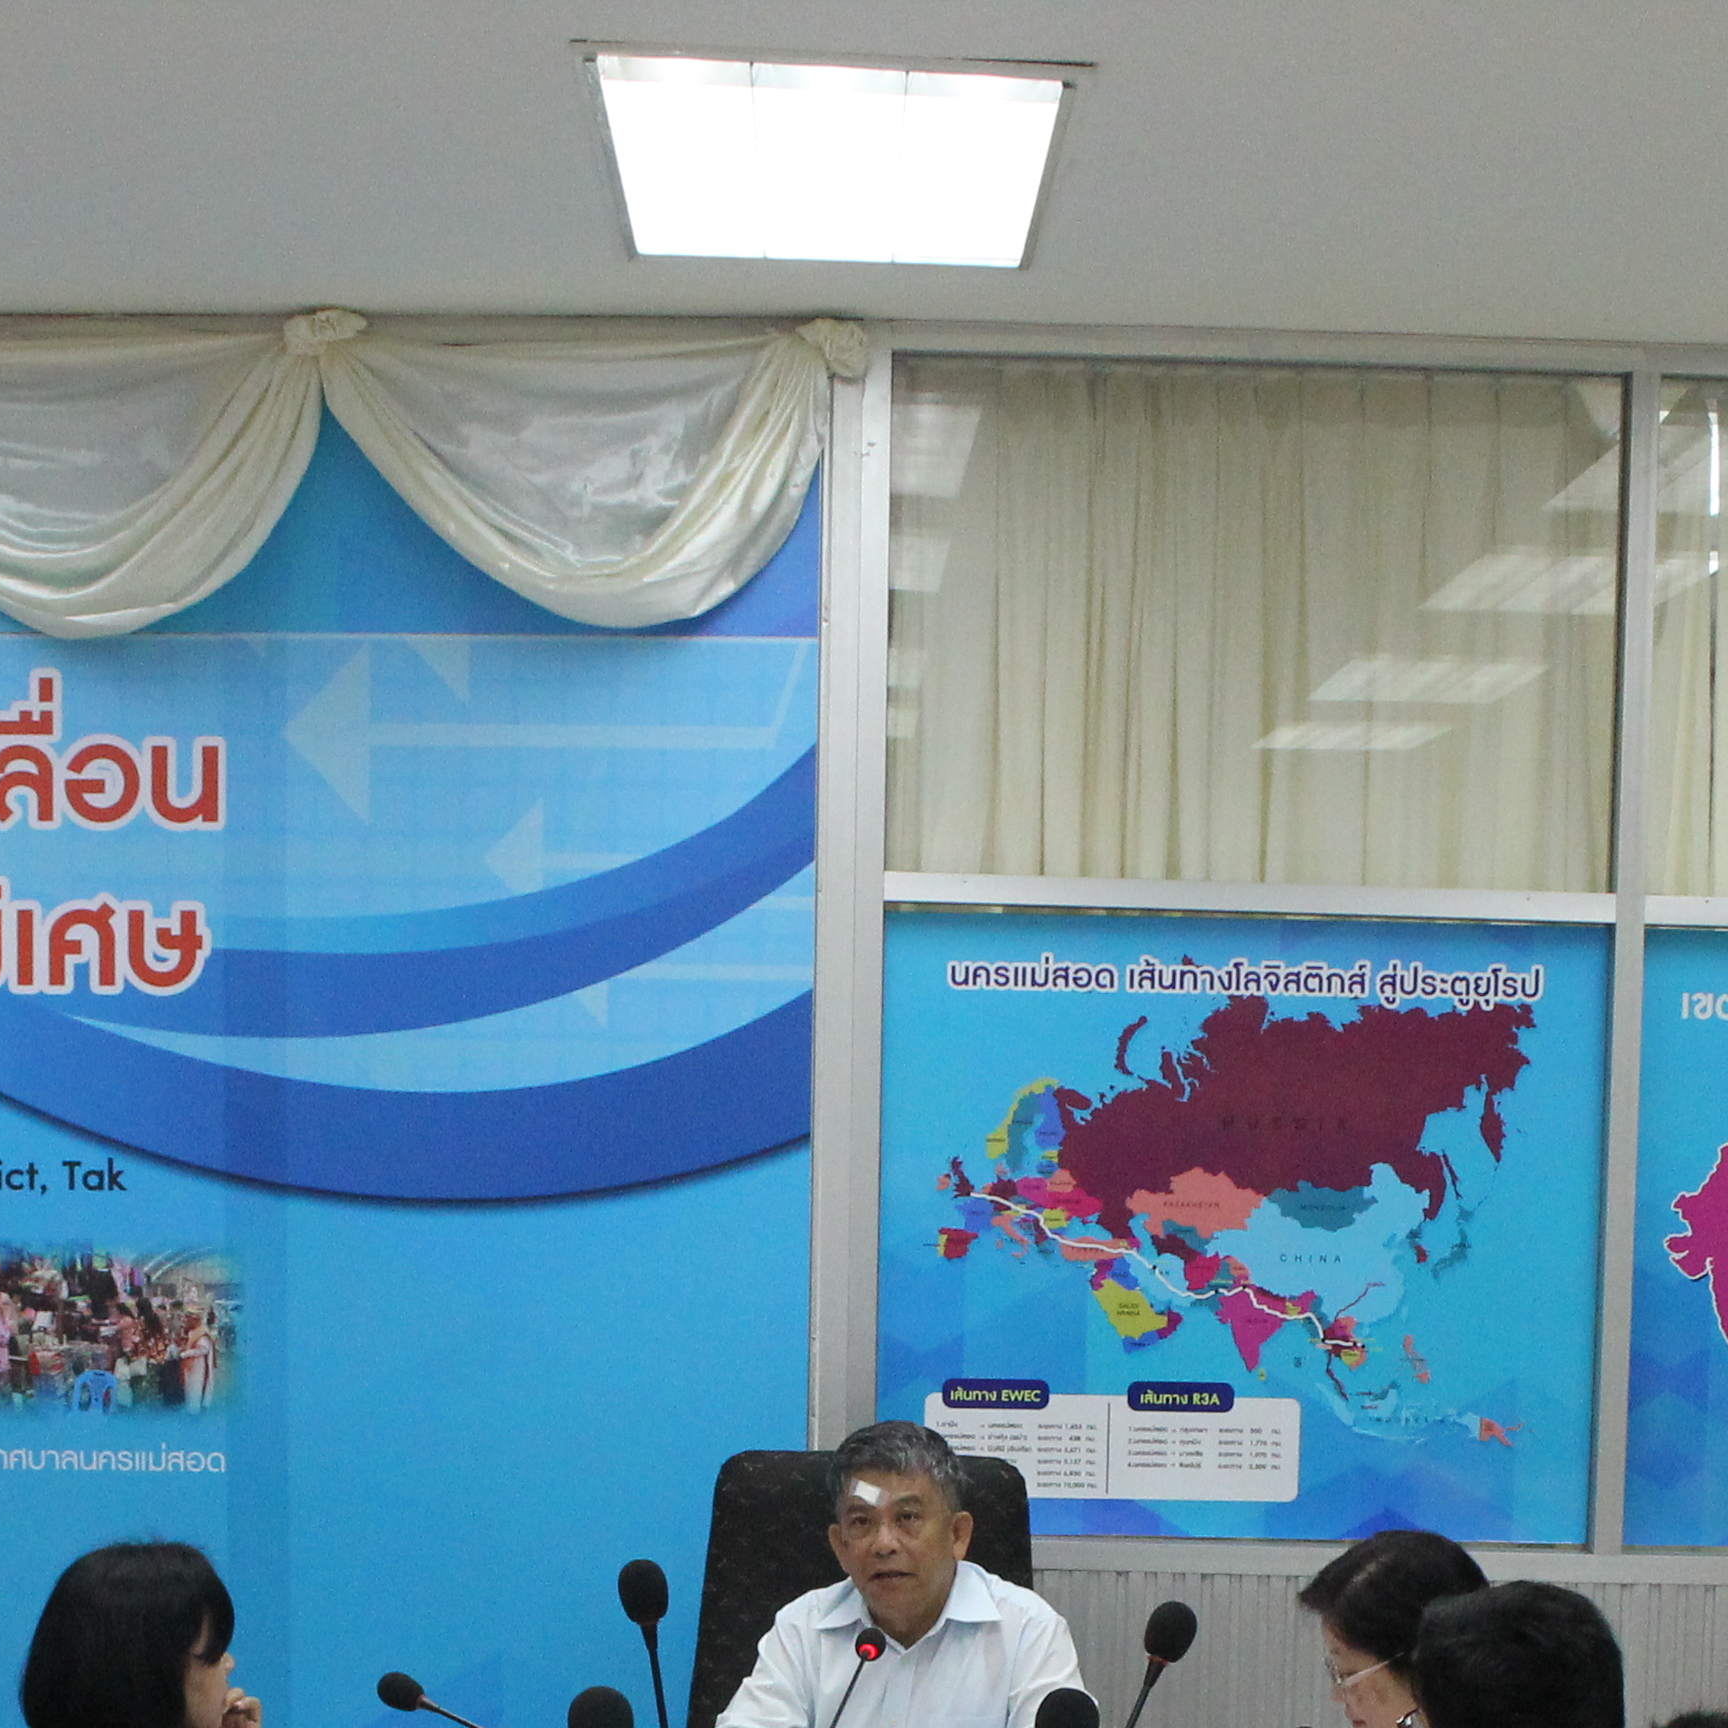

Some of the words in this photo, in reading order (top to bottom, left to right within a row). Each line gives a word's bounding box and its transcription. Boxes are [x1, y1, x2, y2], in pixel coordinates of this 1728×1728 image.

[949, 954, 1117, 990] นครแม่สอด
[1127, 957, 1369, 996] เส้นทางโลจิสติกส์
[1377, 961, 1542, 1008] สู่ประตูยุโรป
[63, 1157, 126, 1192] Tak
[1280, 1253, 1343, 1264] CHINA
[950, 1386, 997, 1402] เส้นทาง
[1001, 1389, 1042, 1402] EWEC
[1140, 1389, 1188, 1405] เส้นทาง
[1192, 1393, 1221, 1406] R3A
